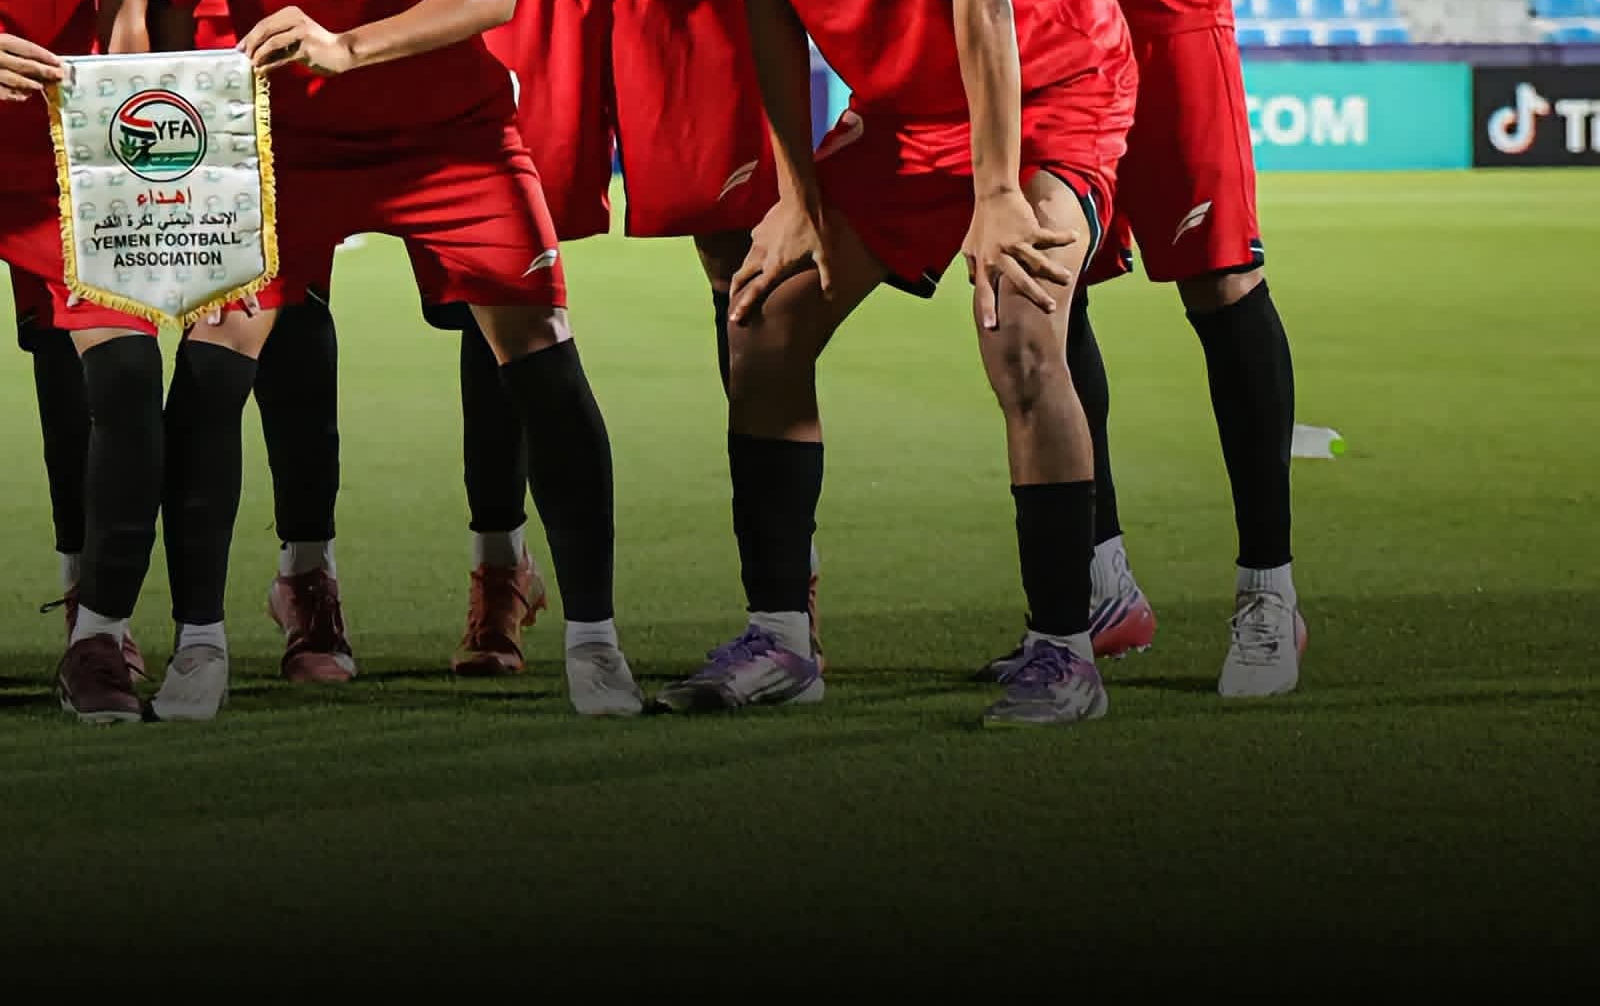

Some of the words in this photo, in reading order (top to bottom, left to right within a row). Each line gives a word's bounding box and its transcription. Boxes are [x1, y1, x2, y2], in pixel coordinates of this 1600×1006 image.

[154, 119, 196, 142] YFA
[91, 234, 150, 250] YEMEN
[155, 232, 241, 247] FOOTBALL
[113, 251, 222, 268] ASSOCIATION
